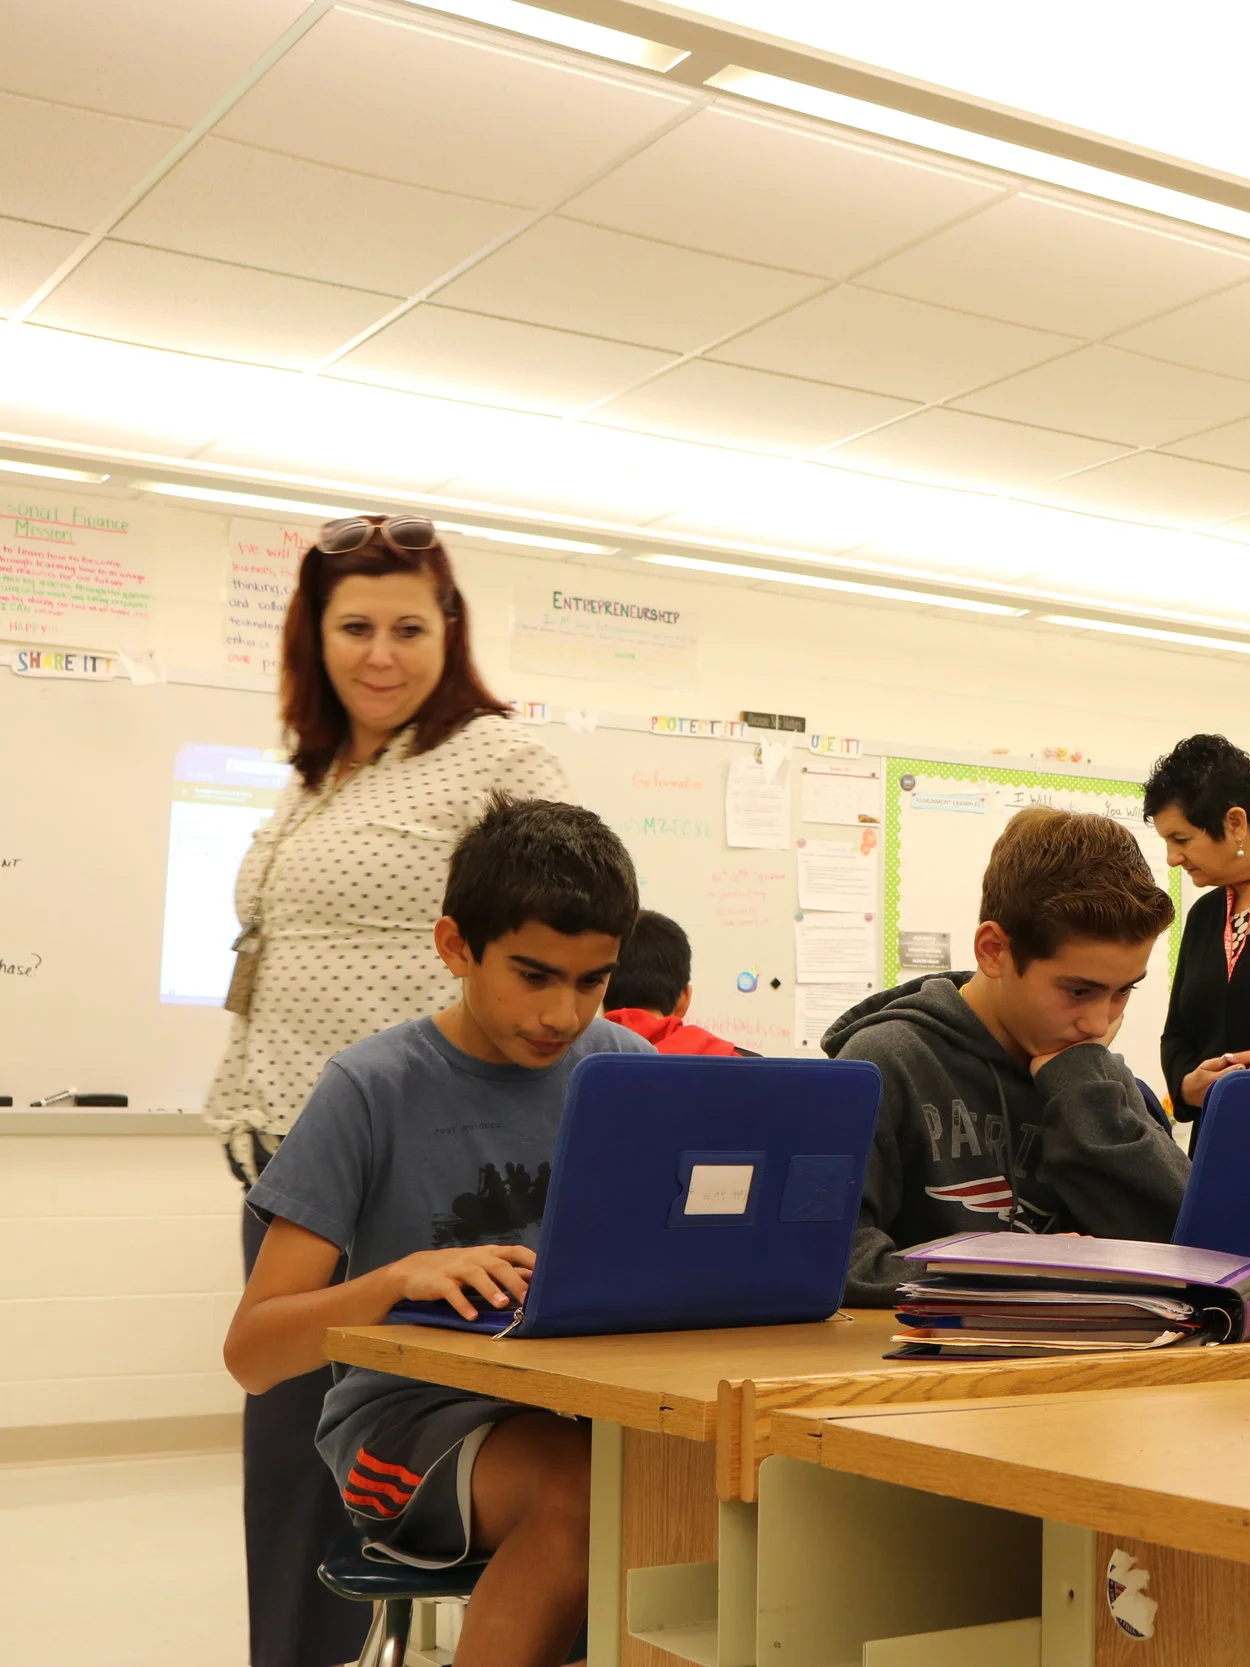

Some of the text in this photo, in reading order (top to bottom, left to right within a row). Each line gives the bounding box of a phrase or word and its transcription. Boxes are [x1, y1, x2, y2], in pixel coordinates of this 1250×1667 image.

[72, 506, 129, 530] Finance
[14, 519, 74, 541] Mission
[17, 651, 77, 672] SHARE
[651, 715, 721, 735] PROTECT
[811, 735, 836, 755] USE
[1102, 801, 1122, 818] You
